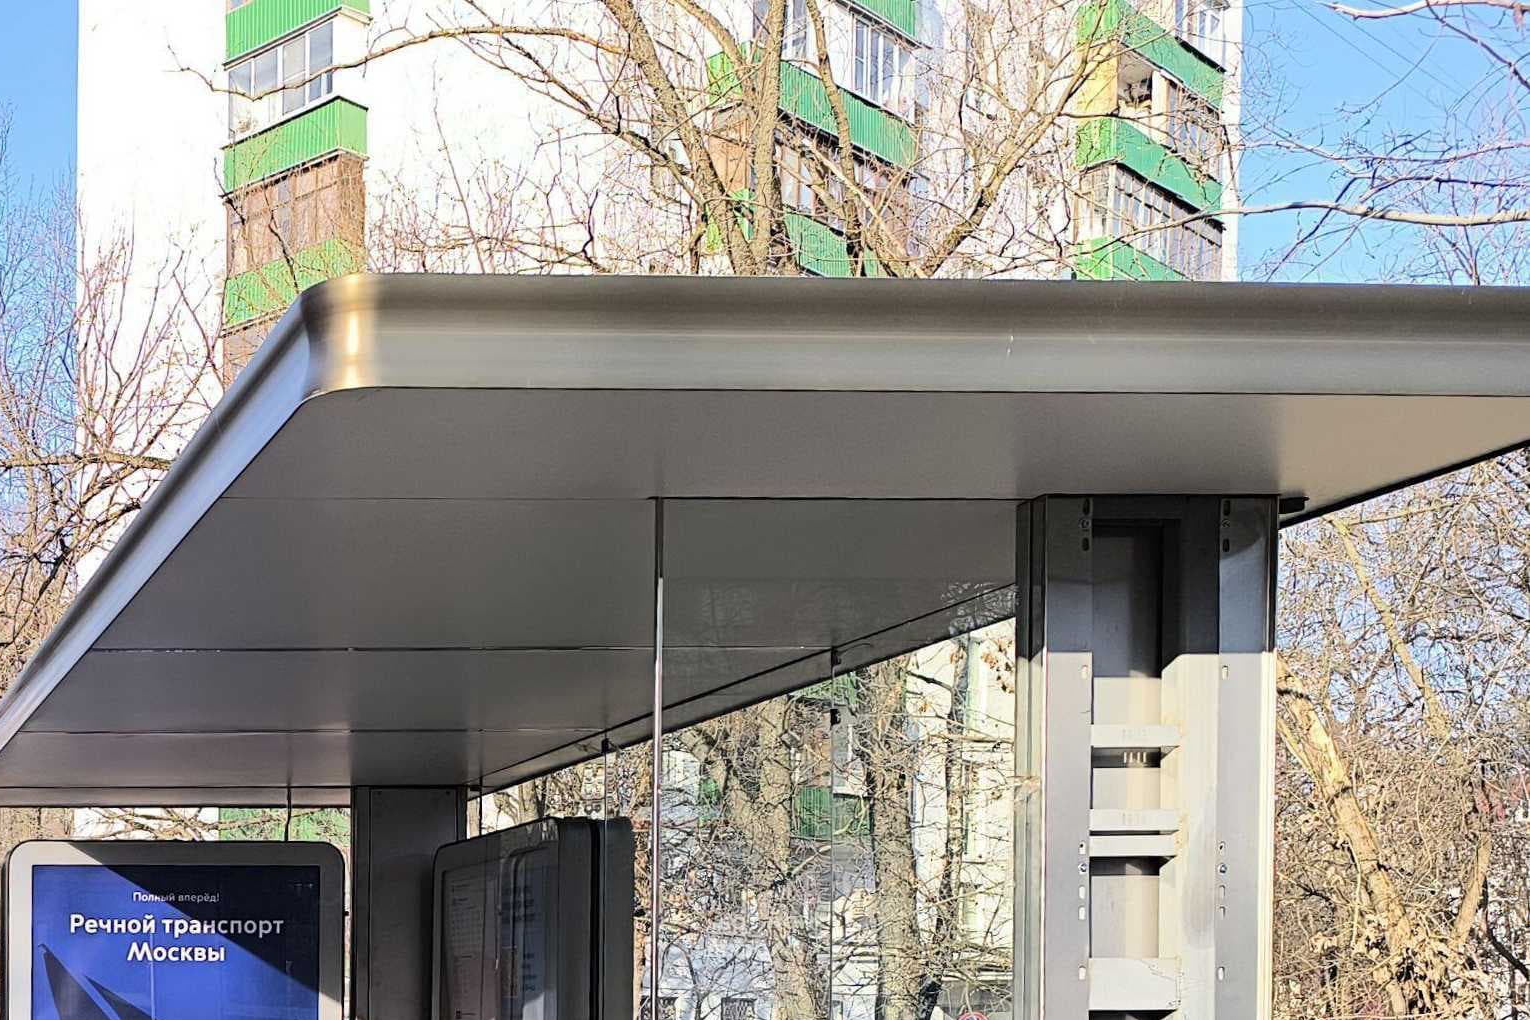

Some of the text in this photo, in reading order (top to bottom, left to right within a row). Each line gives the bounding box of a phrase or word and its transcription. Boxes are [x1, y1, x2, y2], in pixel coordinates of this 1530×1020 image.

[132, 891, 220, 903] Полный вперёд!
[69, 914, 284, 938] Речной транспорт
[126, 942, 225, 961] Москвы
